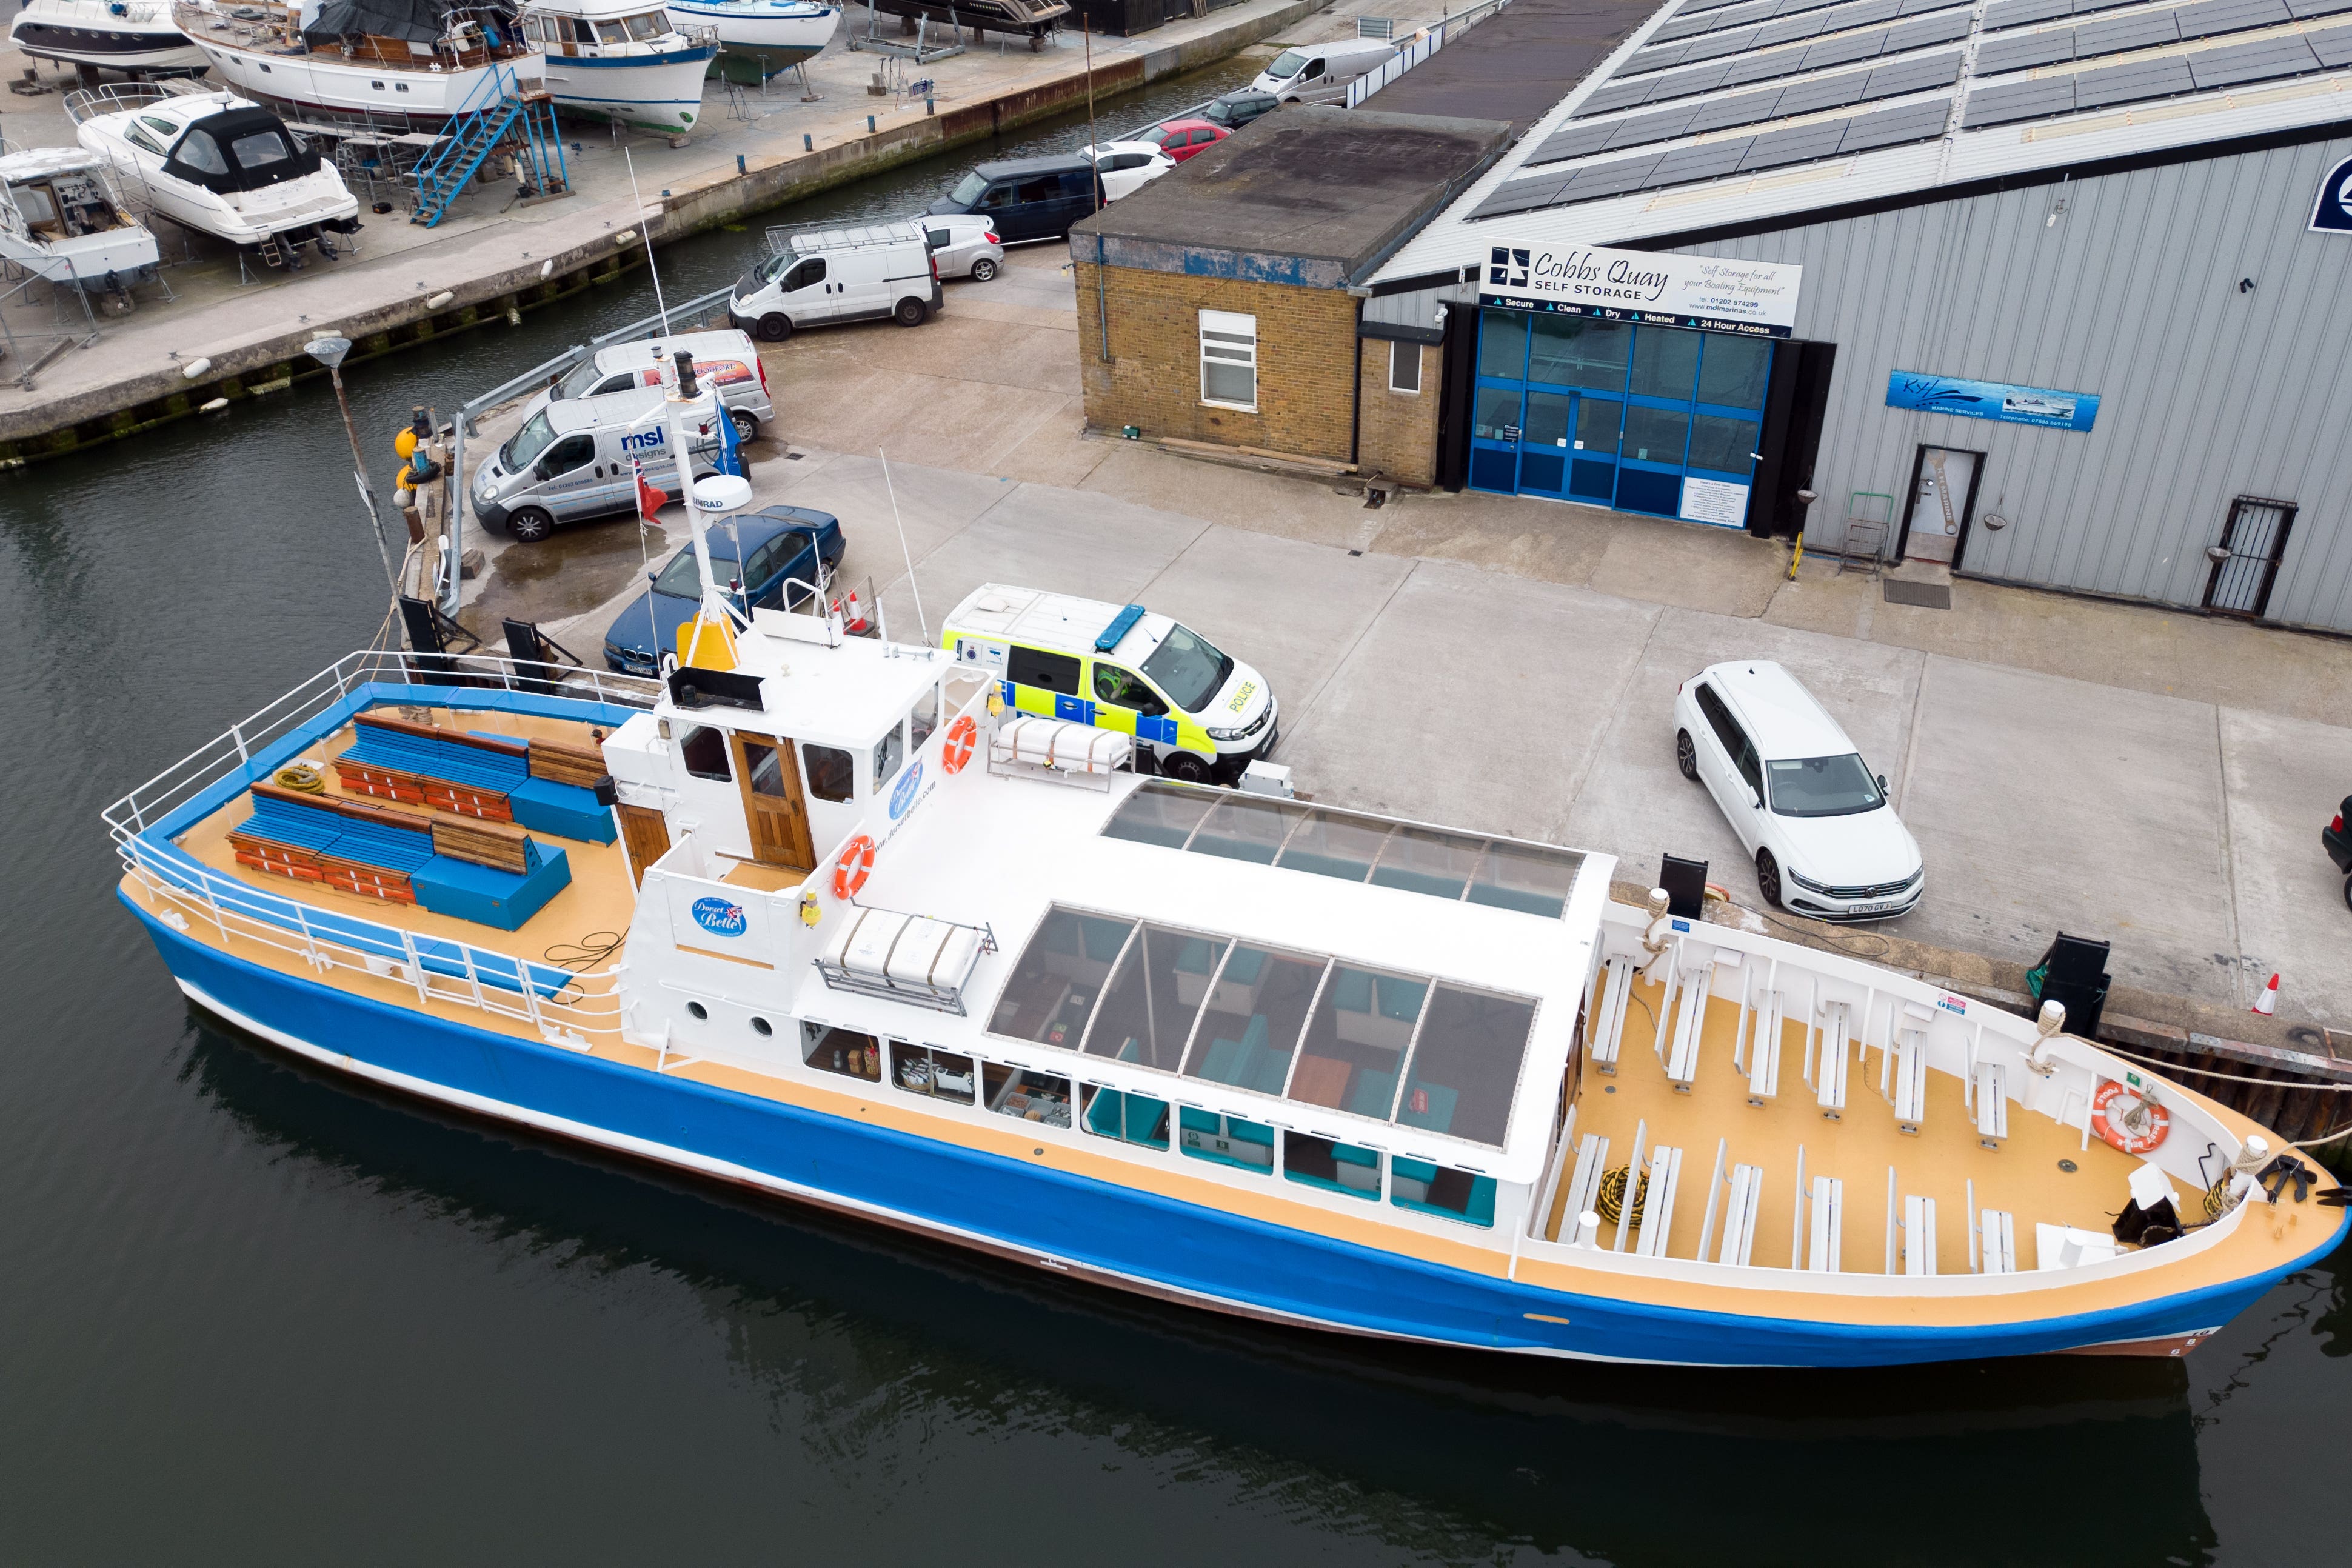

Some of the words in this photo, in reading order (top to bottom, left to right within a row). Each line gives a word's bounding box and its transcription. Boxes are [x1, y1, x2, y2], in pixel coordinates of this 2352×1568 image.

[1535, 251, 1600, 281] Cobbs
[1608, 260, 1668, 301] Quay
[1719, 267, 1749, 282] Storage
[1749, 269, 1762, 282] for
[1763, 270, 1777, 281] all
[1535, 280, 1569, 292] SELF
[1574, 284, 1642, 300] STORAGE
[1682, 279, 1702, 290] your
[1704, 279, 1736, 295] Boating
[1689, 302, 1767, 316] www.mdlmarinas.co.uk
[1711, 297, 1731, 305] 01202
[1733, 299, 1759, 308] 674299
[1505, 298, 1534, 309] Secure
[1557, 304, 1582, 313] Clean
[1605, 309, 1620, 319] Dry
[1645, 313, 1675, 324] Heated
[1701, 319, 1712, 328] 24
[1714, 321, 1736, 331] Hour
[1739, 324, 1770, 335] Access
[1955, 408, 1984, 416] SERVICES
[621, 425, 665, 451] msl
[625, 447, 666, 461] designs
[693, 496, 723, 508] SIMRAD
[1940, 485, 1953, 522] MARINE
[1229, 681, 1256, 712] POLICE
[875, 781, 936, 853] ww.dorsetbelle.com
[694, 902, 724, 913] Dorset
[701, 912, 737, 930] Belle
[2097, 1087, 2119, 1104] POOLE
[2147, 1113, 2160, 1144] DRSET
